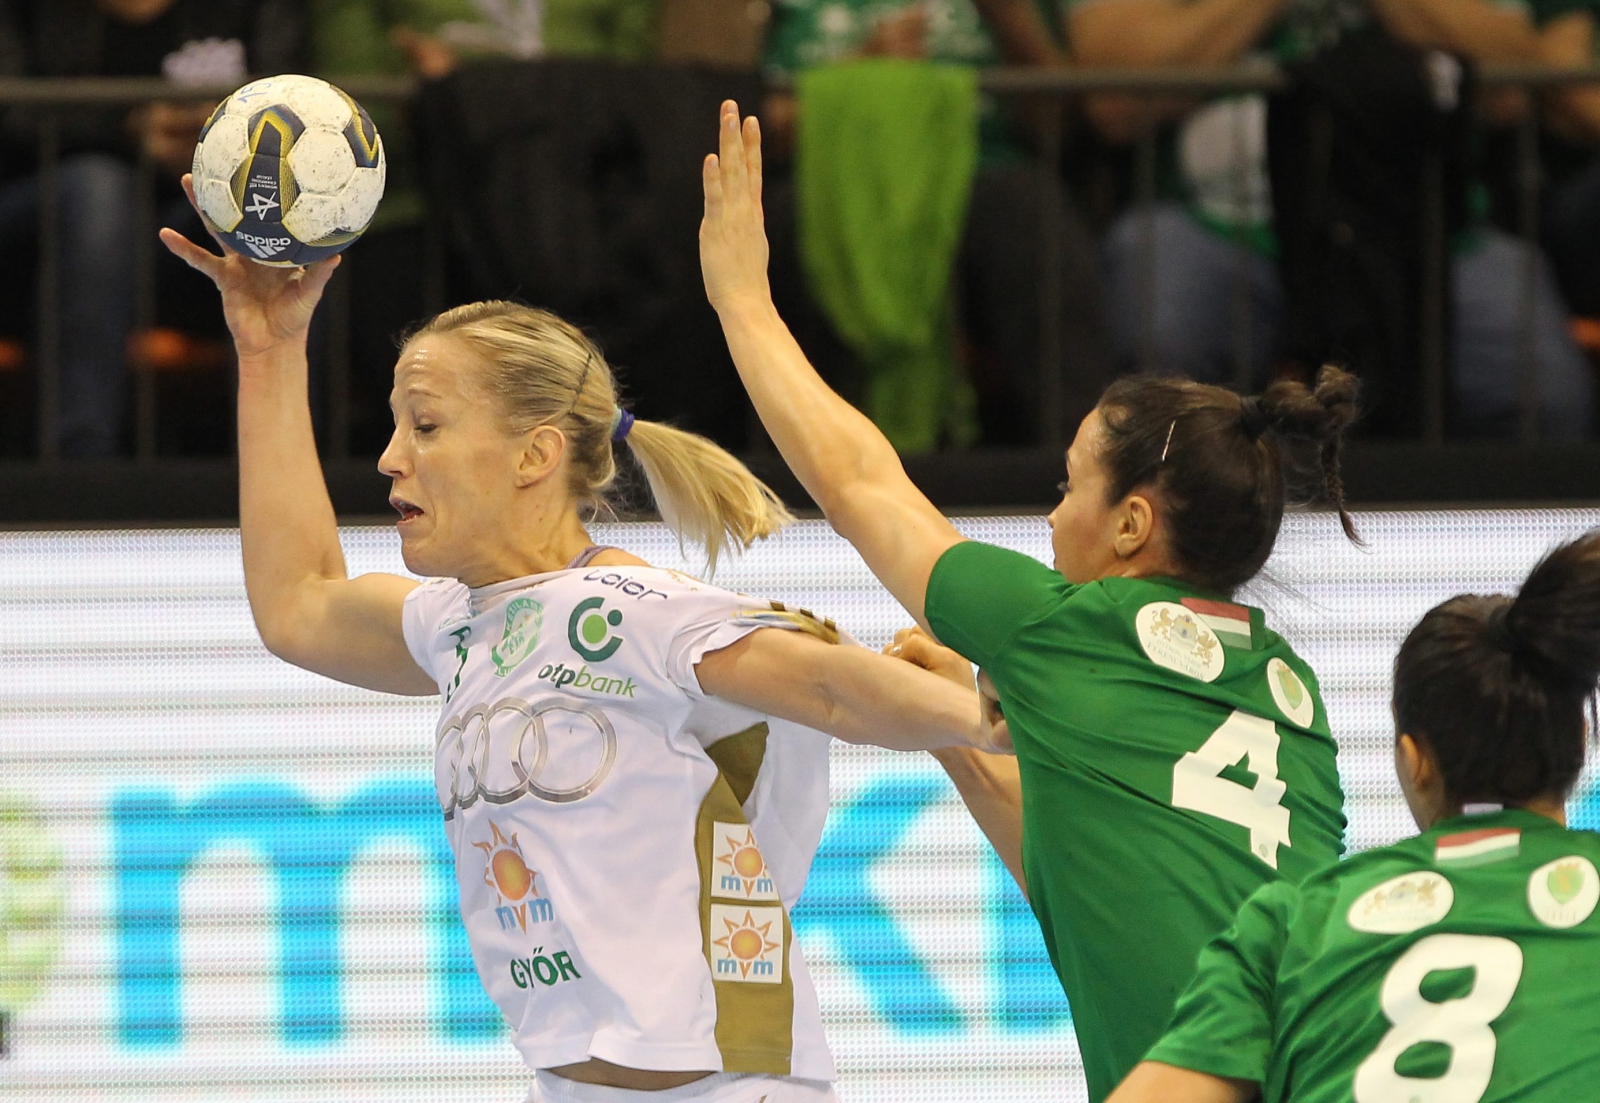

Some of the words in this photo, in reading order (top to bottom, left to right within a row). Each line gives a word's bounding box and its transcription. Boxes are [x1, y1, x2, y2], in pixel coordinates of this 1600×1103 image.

[236, 230, 291, 247] adidas
[1172, 709, 1292, 870] 4
[510, 946, 582, 989] GYŐR
[1353, 933, 1524, 1103] 8
